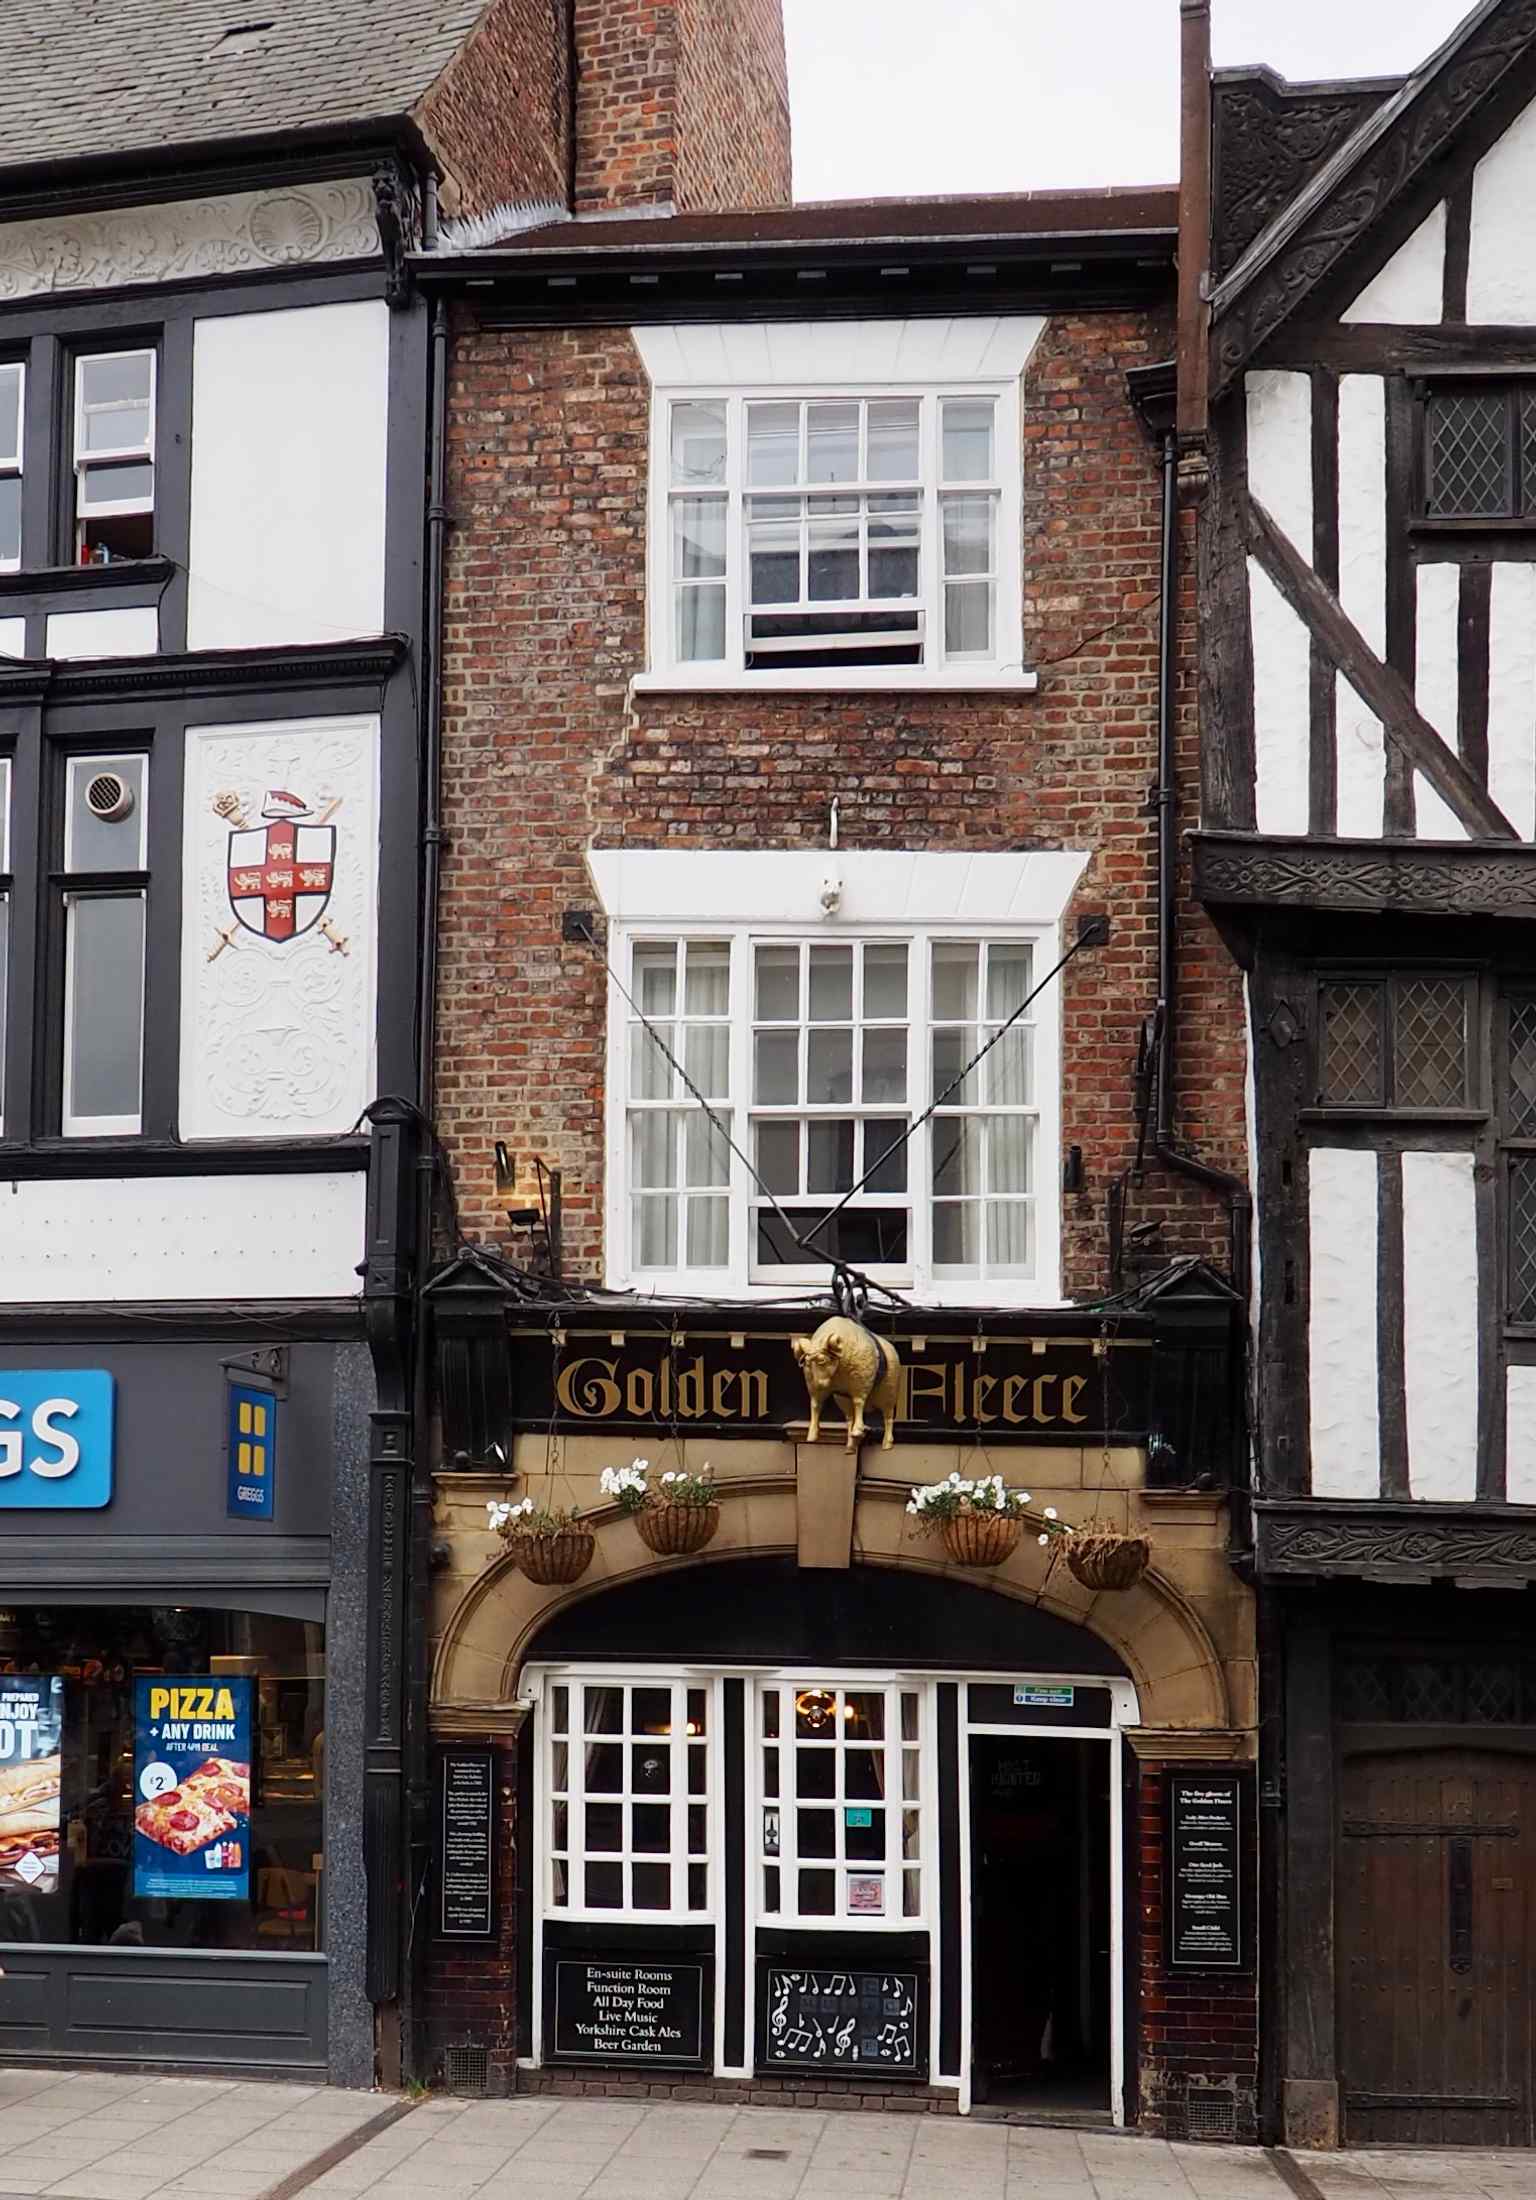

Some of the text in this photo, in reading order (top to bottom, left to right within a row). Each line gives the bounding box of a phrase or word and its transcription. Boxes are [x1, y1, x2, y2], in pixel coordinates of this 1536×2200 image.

[557, 1355, 1089, 1424] Golden Fleece
[150, 1687, 236, 1720] PIZZA
[161, 1723, 190, 1740] ANY
[193, 1723, 236, 1740] DRINK
[166, 1742, 187, 1752] AFTER
[586, 1967, 673, 1981] En-suite Rooms
[586, 1981, 671, 1995] Function Room
[593, 1995, 664, 2010] All Day Food
[599, 2010, 658, 2023] Live Music
[575, 2023, 682, 2038] Yorkshire Cask Ales
[594, 2038, 662, 2052] Beer Garden
